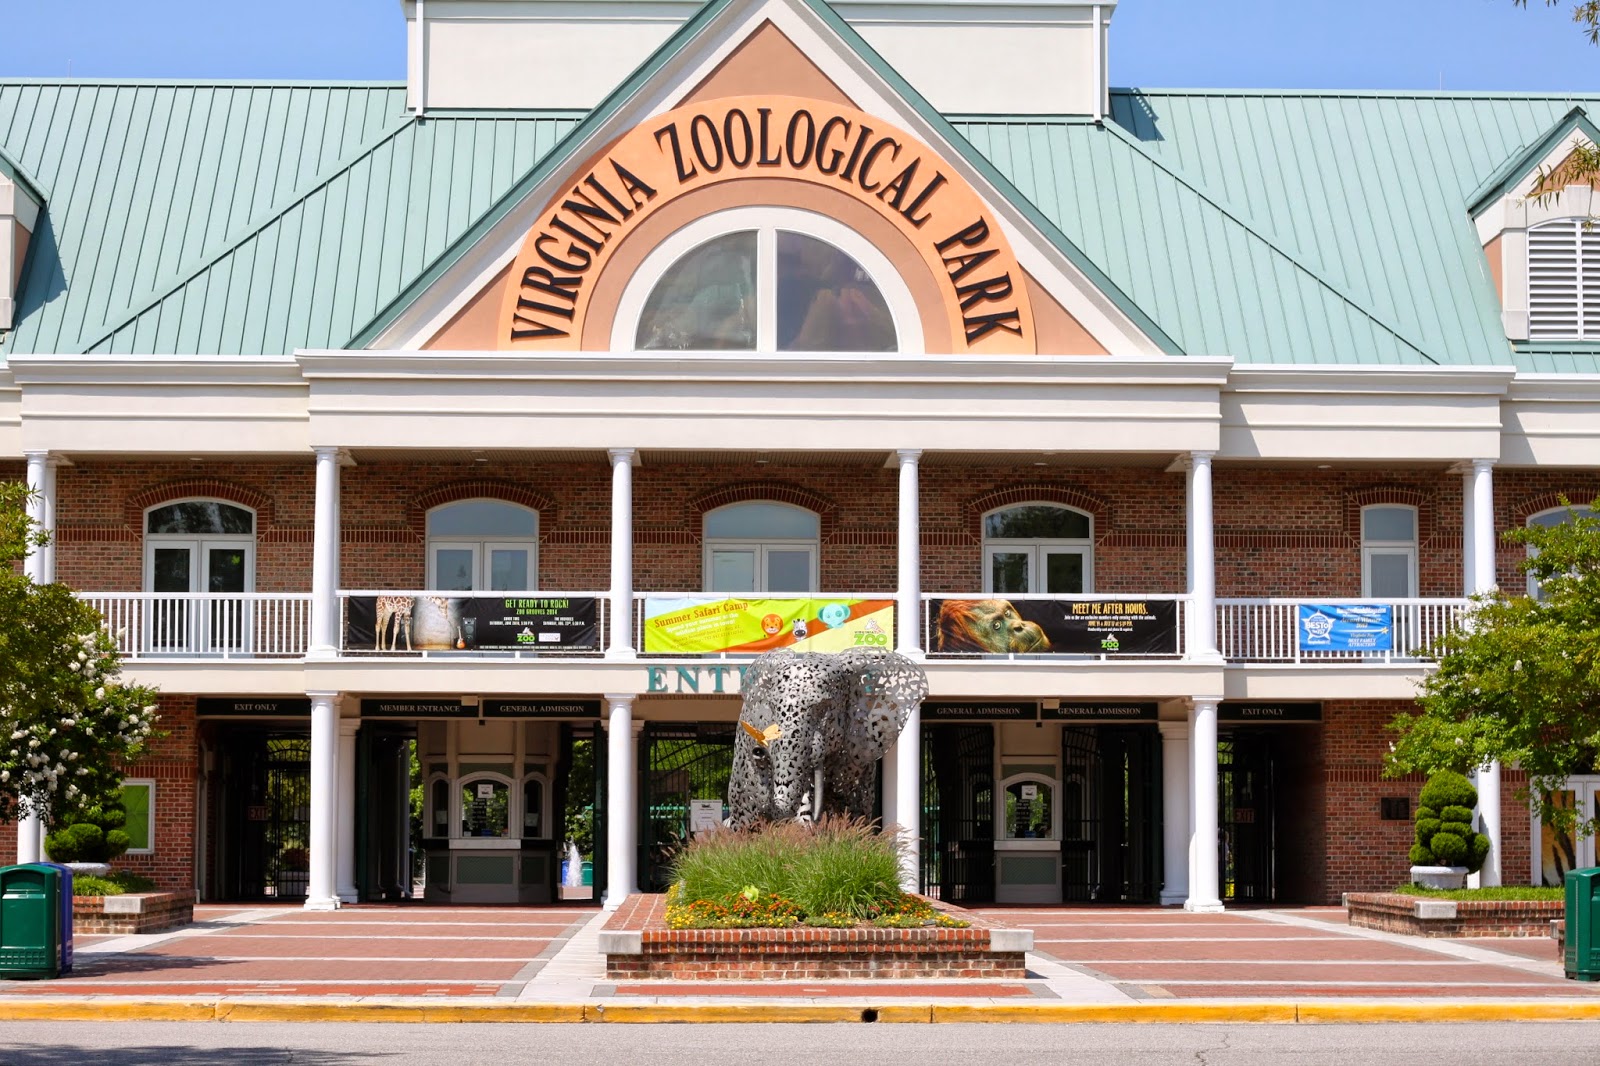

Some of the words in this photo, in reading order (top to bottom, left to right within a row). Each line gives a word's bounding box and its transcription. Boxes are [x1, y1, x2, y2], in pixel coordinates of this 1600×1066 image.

[511, 157, 658, 342] VIRGINIA
[654, 107, 948, 228] ZOOLOGICAL
[934, 214, 1023, 346] PARK
[505, 599, 516, 609] GET
[519, 599, 538, 609] READY
[541, 599, 549, 609] TO
[551, 599, 569, 609] ROCK!
[1072, 603, 1090, 614] MEET
[1092, 603, 1102, 614] ME
[1103, 603, 1123, 614] AFTER
[1125, 603, 1149, 614] HOURS.
[654, 613, 691, 628] Summer
[693, 605, 721, 619] Safari
[723, 601, 749, 612] Camp
[854, 634, 888, 646] ZOO
[234, 703, 253, 711] EXIT
[254, 703, 278, 711] ONLY
[1058, 707, 1096, 715] GENERAL
[1097, 707, 1142, 715] ADMISSION
